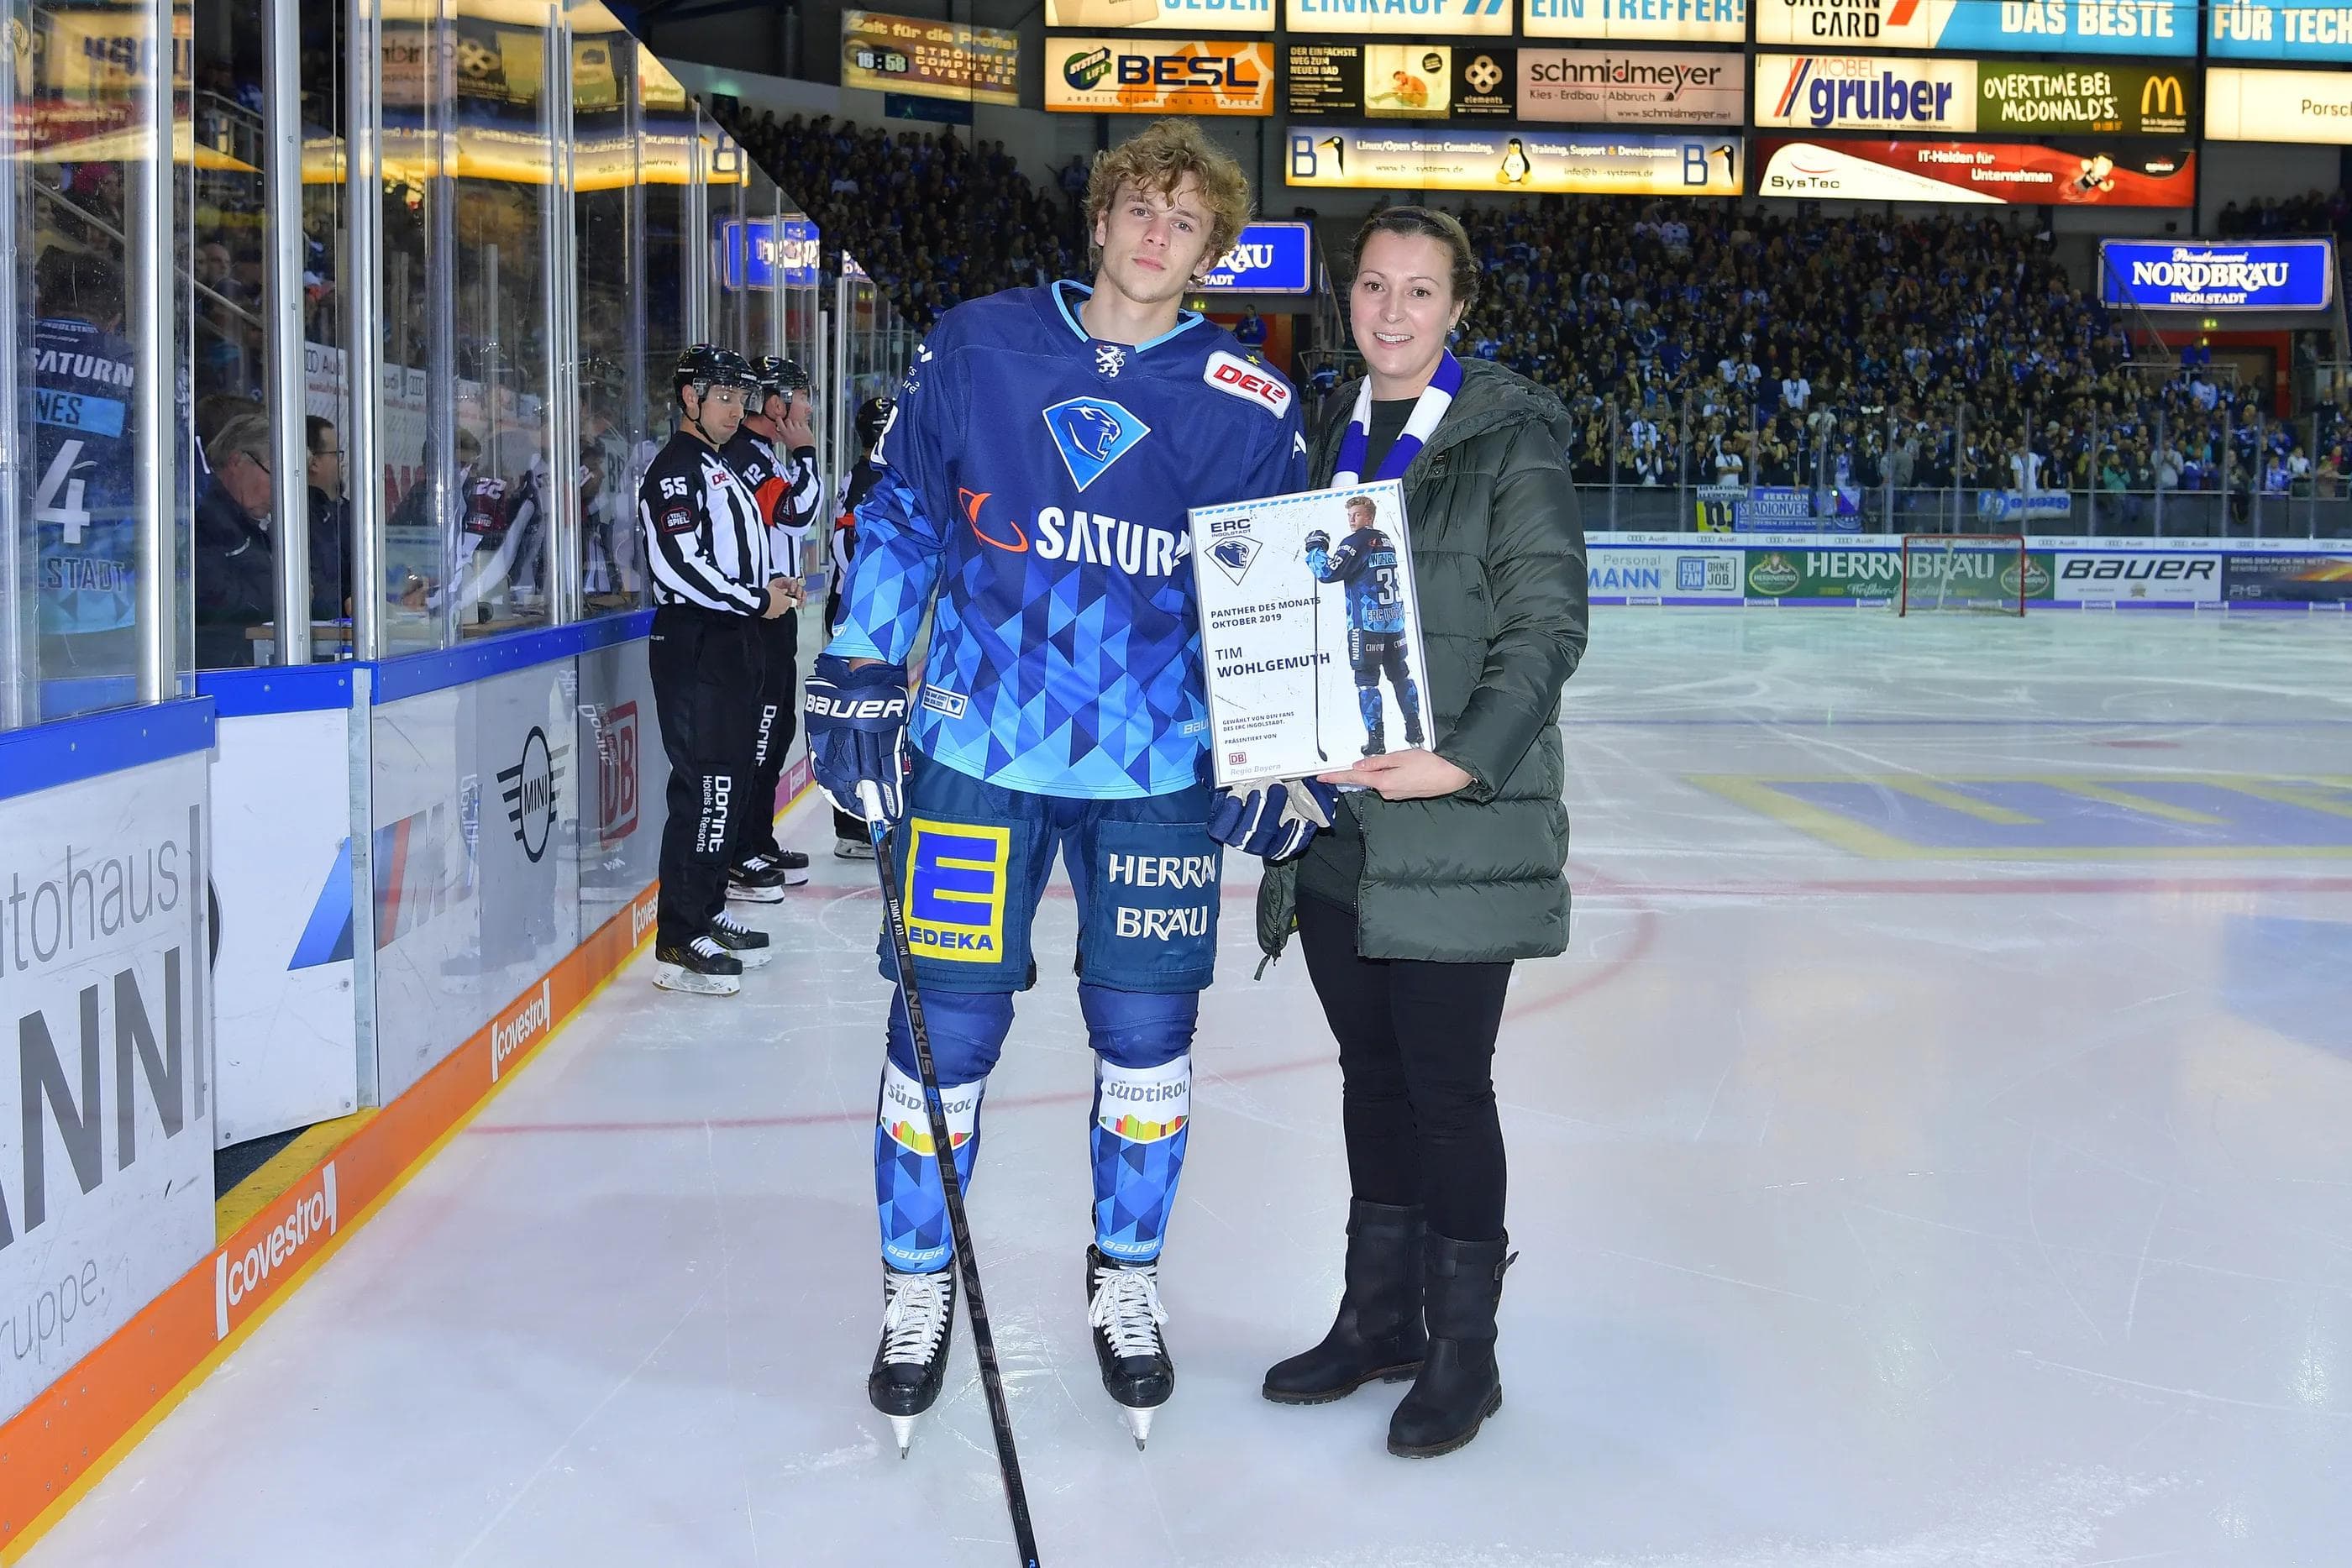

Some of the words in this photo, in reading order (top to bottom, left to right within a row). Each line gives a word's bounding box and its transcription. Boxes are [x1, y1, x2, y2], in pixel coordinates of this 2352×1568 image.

[848, 17, 888, 35] Zeit
[893, 24, 921, 39] für
[927, 28, 954, 43] die
[1813, 11, 1879, 38] CARD
[2002, 0, 2066, 34] DAS
[2077, 1, 2174, 38] BESTE
[2214, 0, 2272, 41] FÜR
[1290, 47, 1307, 56] DER
[1309, 47, 1357, 57] EINFACHSTE
[1290, 56, 1310, 66] WEG
[1310, 56, 1330, 66] ZUM
[915, 55, 1016, 76] COMPUTER
[920, 66, 1011, 85] SYSTEMS
[1117, 55, 1259, 87] BESL
[1290, 66, 1319, 75] NEUEN
[1320, 66, 1339, 76] BAD
[1530, 58, 1721, 93] schmidmeyer
[1464, 96, 1504, 104] elements
[1530, 89, 1552, 100] Kies
[1560, 90, 1599, 101] Erdbau
[1608, 91, 1656, 102] Abbruch
[1809, 71, 1953, 126] gruber
[1570, 144, 1606, 157] Support
[1617, 145, 1677, 158] Development
[1971, 170, 2054, 183] Unternehmen
[2132, 260, 2289, 292] NORDBRÄU
[2170, 291, 2248, 304] INGOLSTADT
[1213, 364, 1286, 405] DEL
[742, 463, 767, 486] 12
[35, 439, 91, 544] 4
[659, 475, 688, 500] 55
[1210, 518, 1251, 533] ERC
[1211, 529, 1251, 538] INGOLSTADT
[1603, 554, 1661, 566] Personal
[1682, 561, 1704, 574] KEIN
[1707, 562, 1730, 572] OHNE
[1682, 574, 1703, 586] FAN
[1210, 606, 1257, 619] PANTHER
[1258, 602, 1276, 612] DES
[1278, 596, 1321, 610] MONATS
[1211, 616, 1257, 629] OKTOBER
[1259, 613, 1282, 623] 2019
[1215, 647, 1243, 661] TIM
[1217, 653, 1331, 679] WOHLGEMUTH
[755, 705, 777, 767] Dorint
[1231, 753, 1244, 763] DB
[524, 774, 548, 816] MINI
[703, 775, 713, 805] Hotels
[708, 775, 732, 853] Dorint
[696, 816, 711, 852] Resorts
[1109, 853, 1217, 890] HERRN
[1116, 905, 1208, 942] BRÄU
[908, 925, 994, 952] EDEKA
[497, 998, 546, 1063] covestro
[906, 989, 935, 1076] NEXUS
[227, 1199, 326, 1306] covestro
